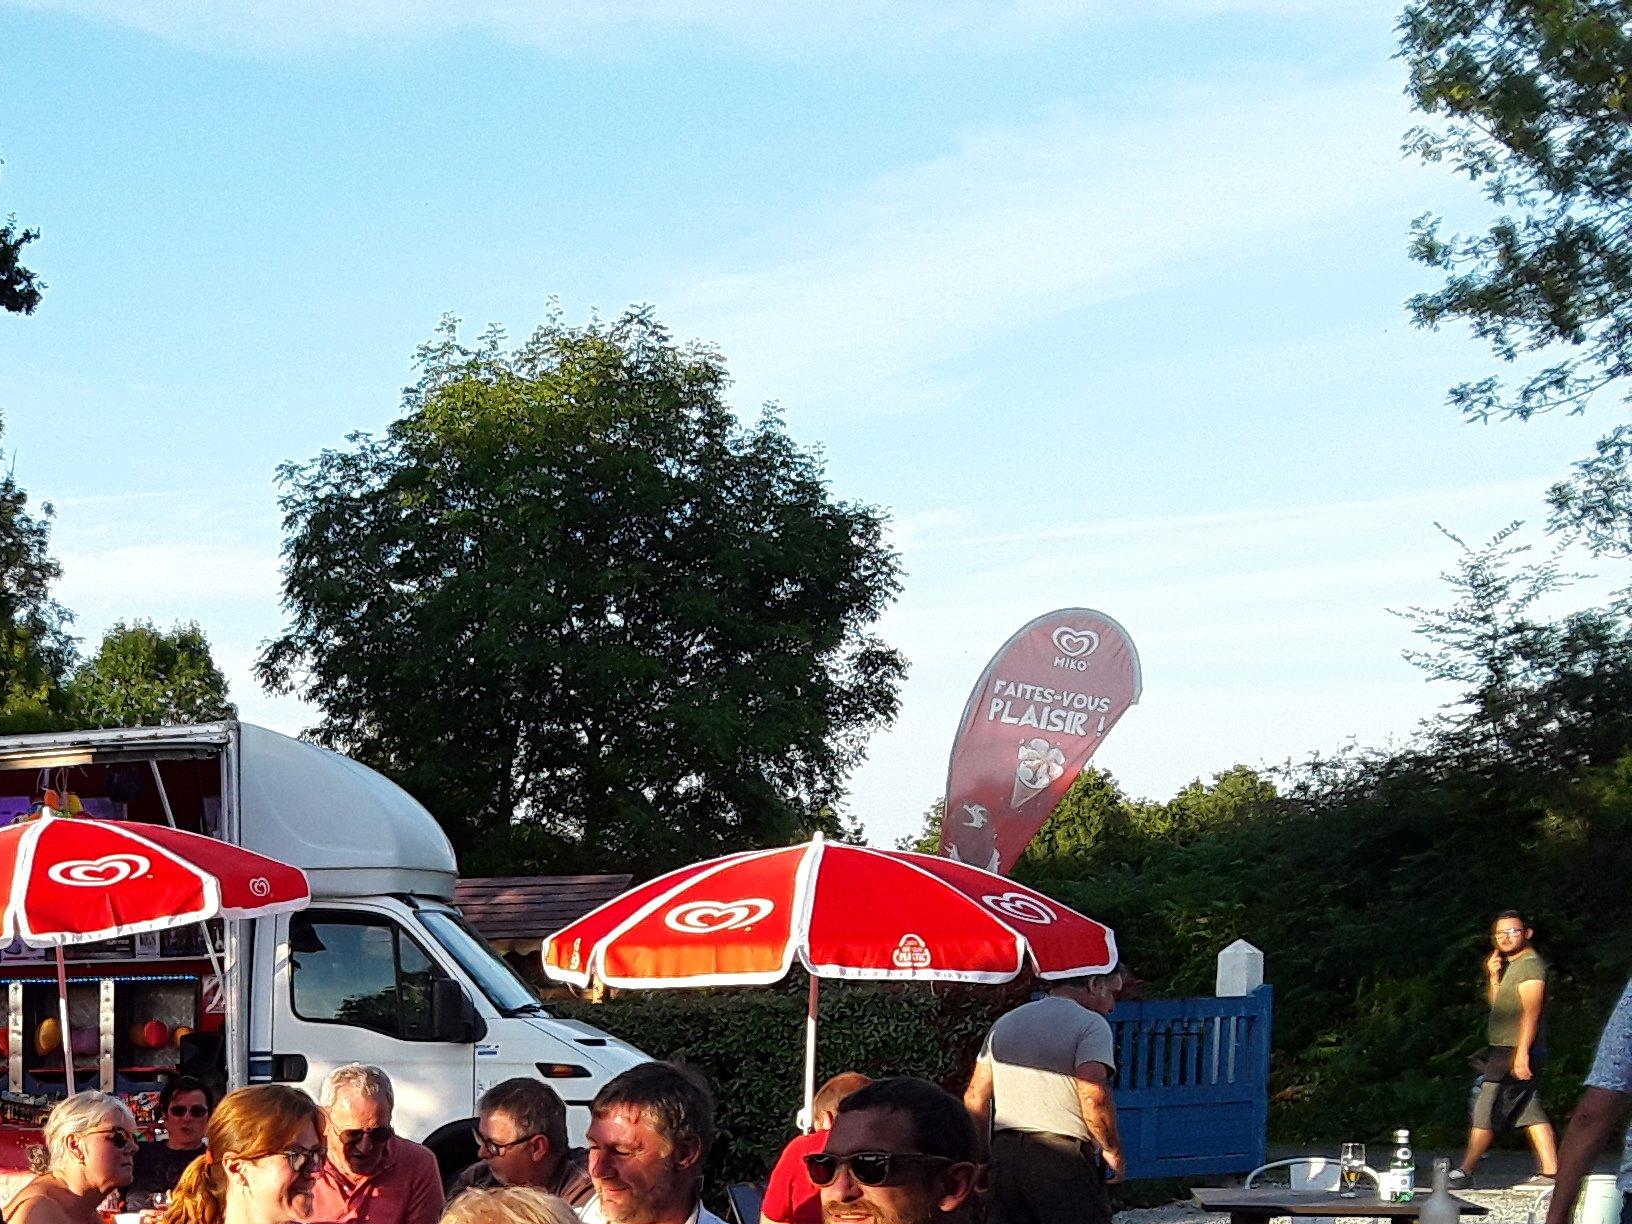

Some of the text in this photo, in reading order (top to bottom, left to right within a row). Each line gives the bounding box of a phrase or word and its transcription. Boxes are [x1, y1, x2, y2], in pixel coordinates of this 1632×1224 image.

[1054, 657, 1087, 671] MIKO
[994, 680, 1111, 712] FAITES-VOUS
[988, 698, 1106, 738] PLAISIR !
